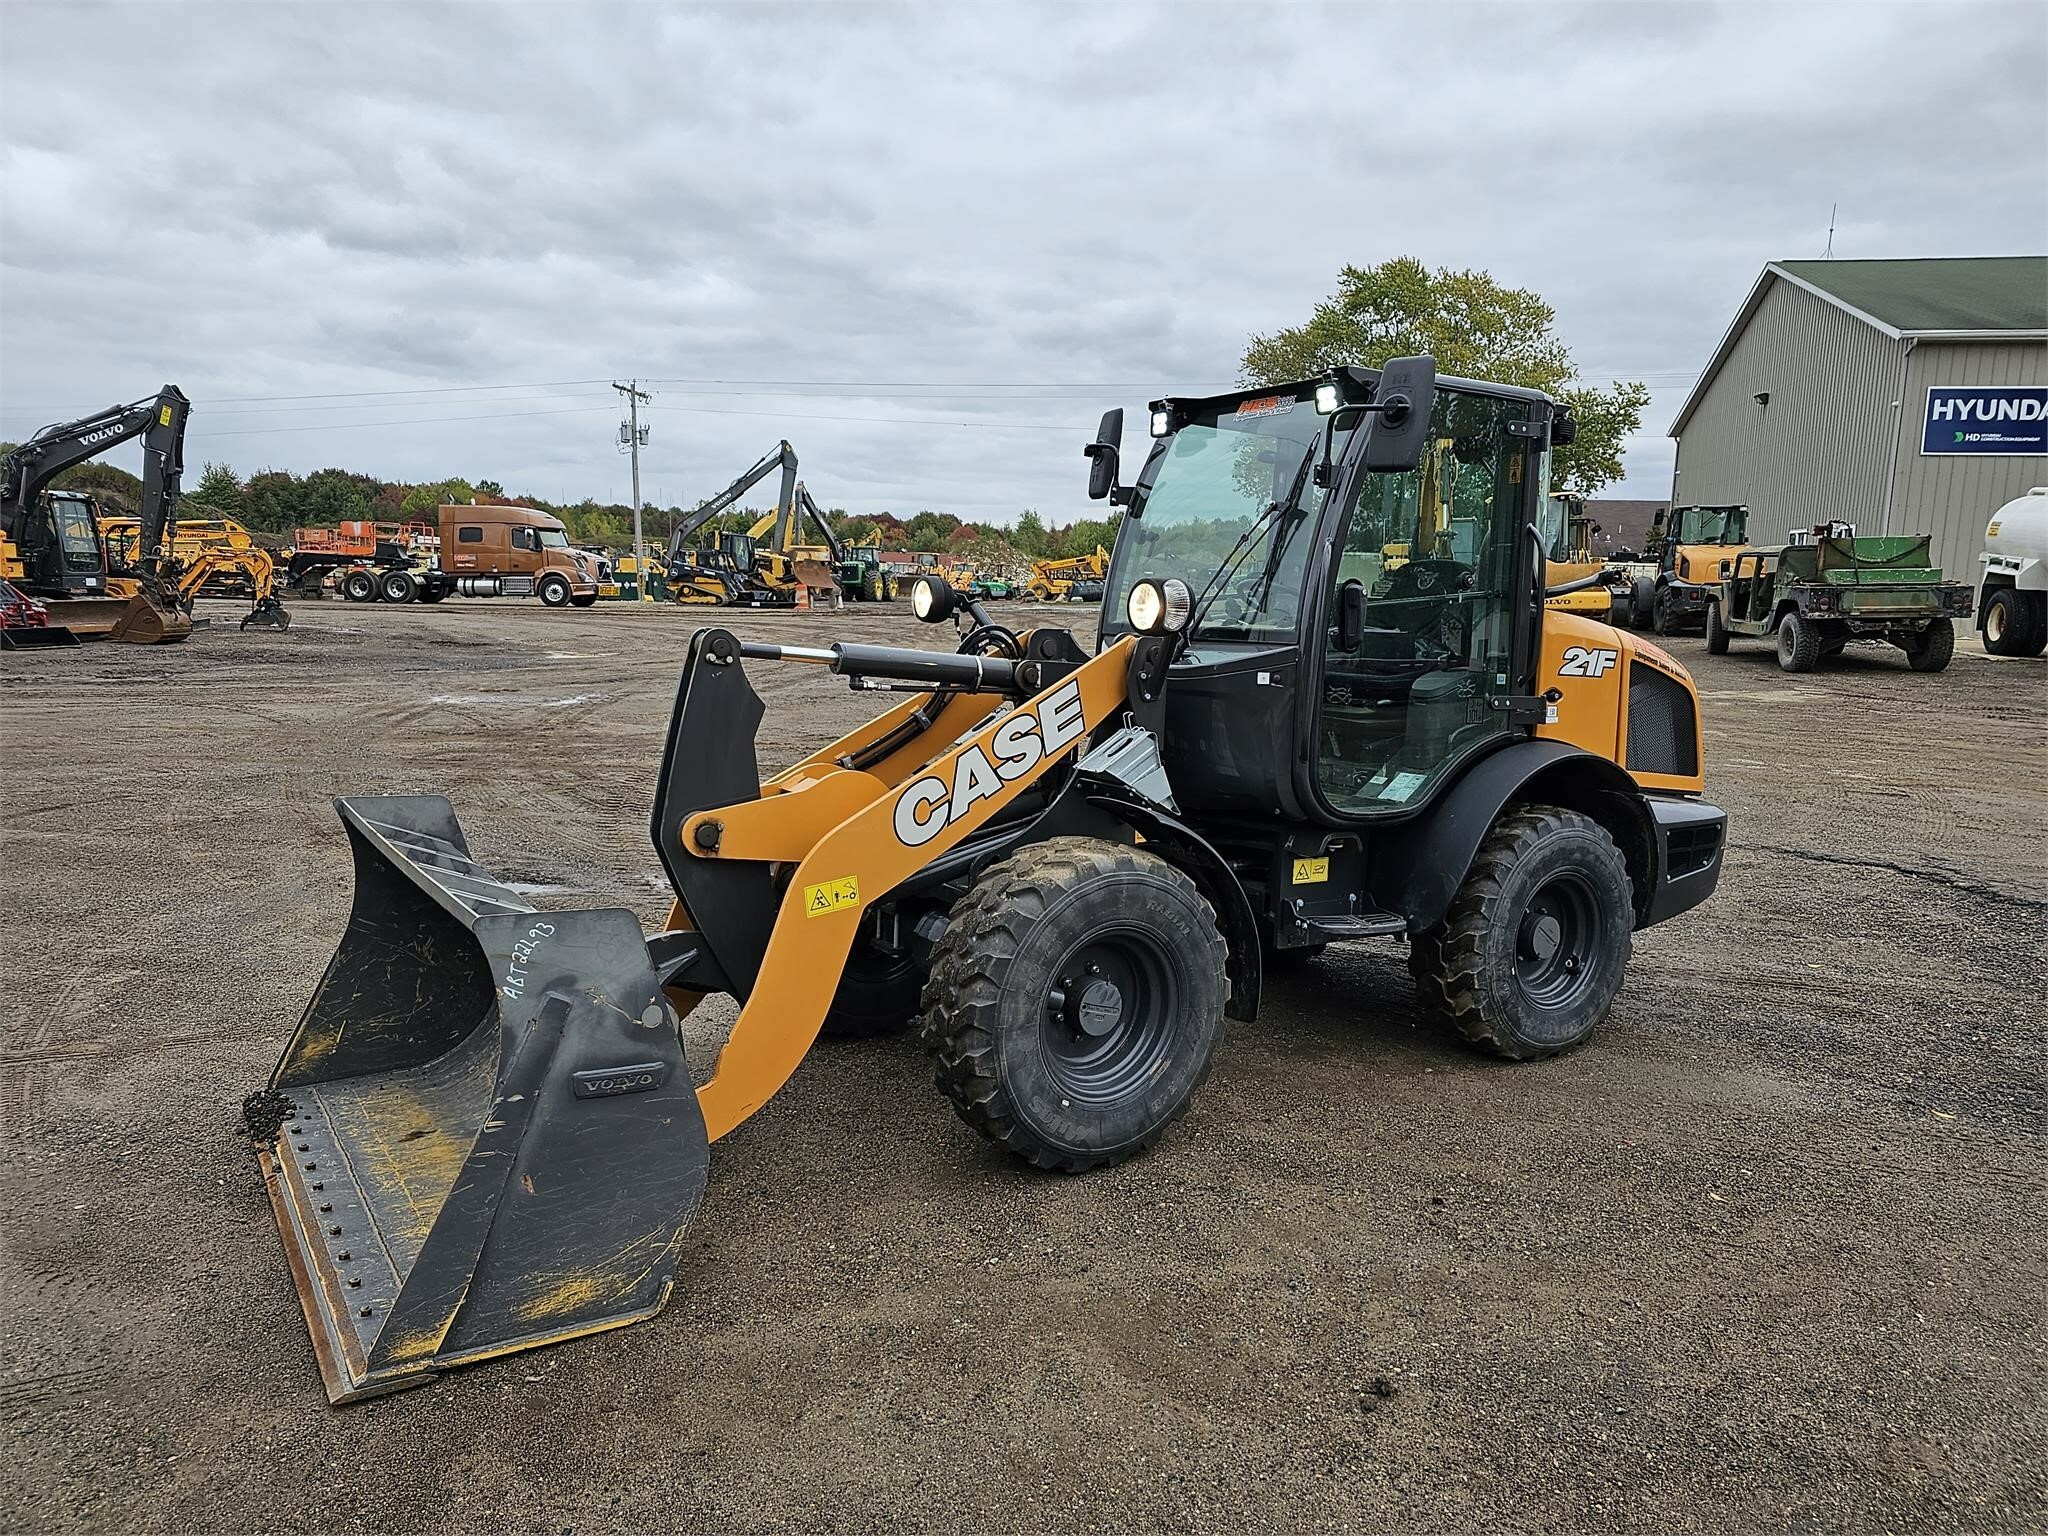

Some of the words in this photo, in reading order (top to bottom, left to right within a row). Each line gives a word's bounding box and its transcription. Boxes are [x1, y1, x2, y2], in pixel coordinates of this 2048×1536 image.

[78, 424, 124, 446] VOLVO
[1965, 433, 1980, 441] HD
[711, 493, 732, 509] VOLVO
[1558, 646, 1618, 678] 21F
[893, 677, 1086, 847] CASE
[584, 1073, 652, 1091] VOLVO
